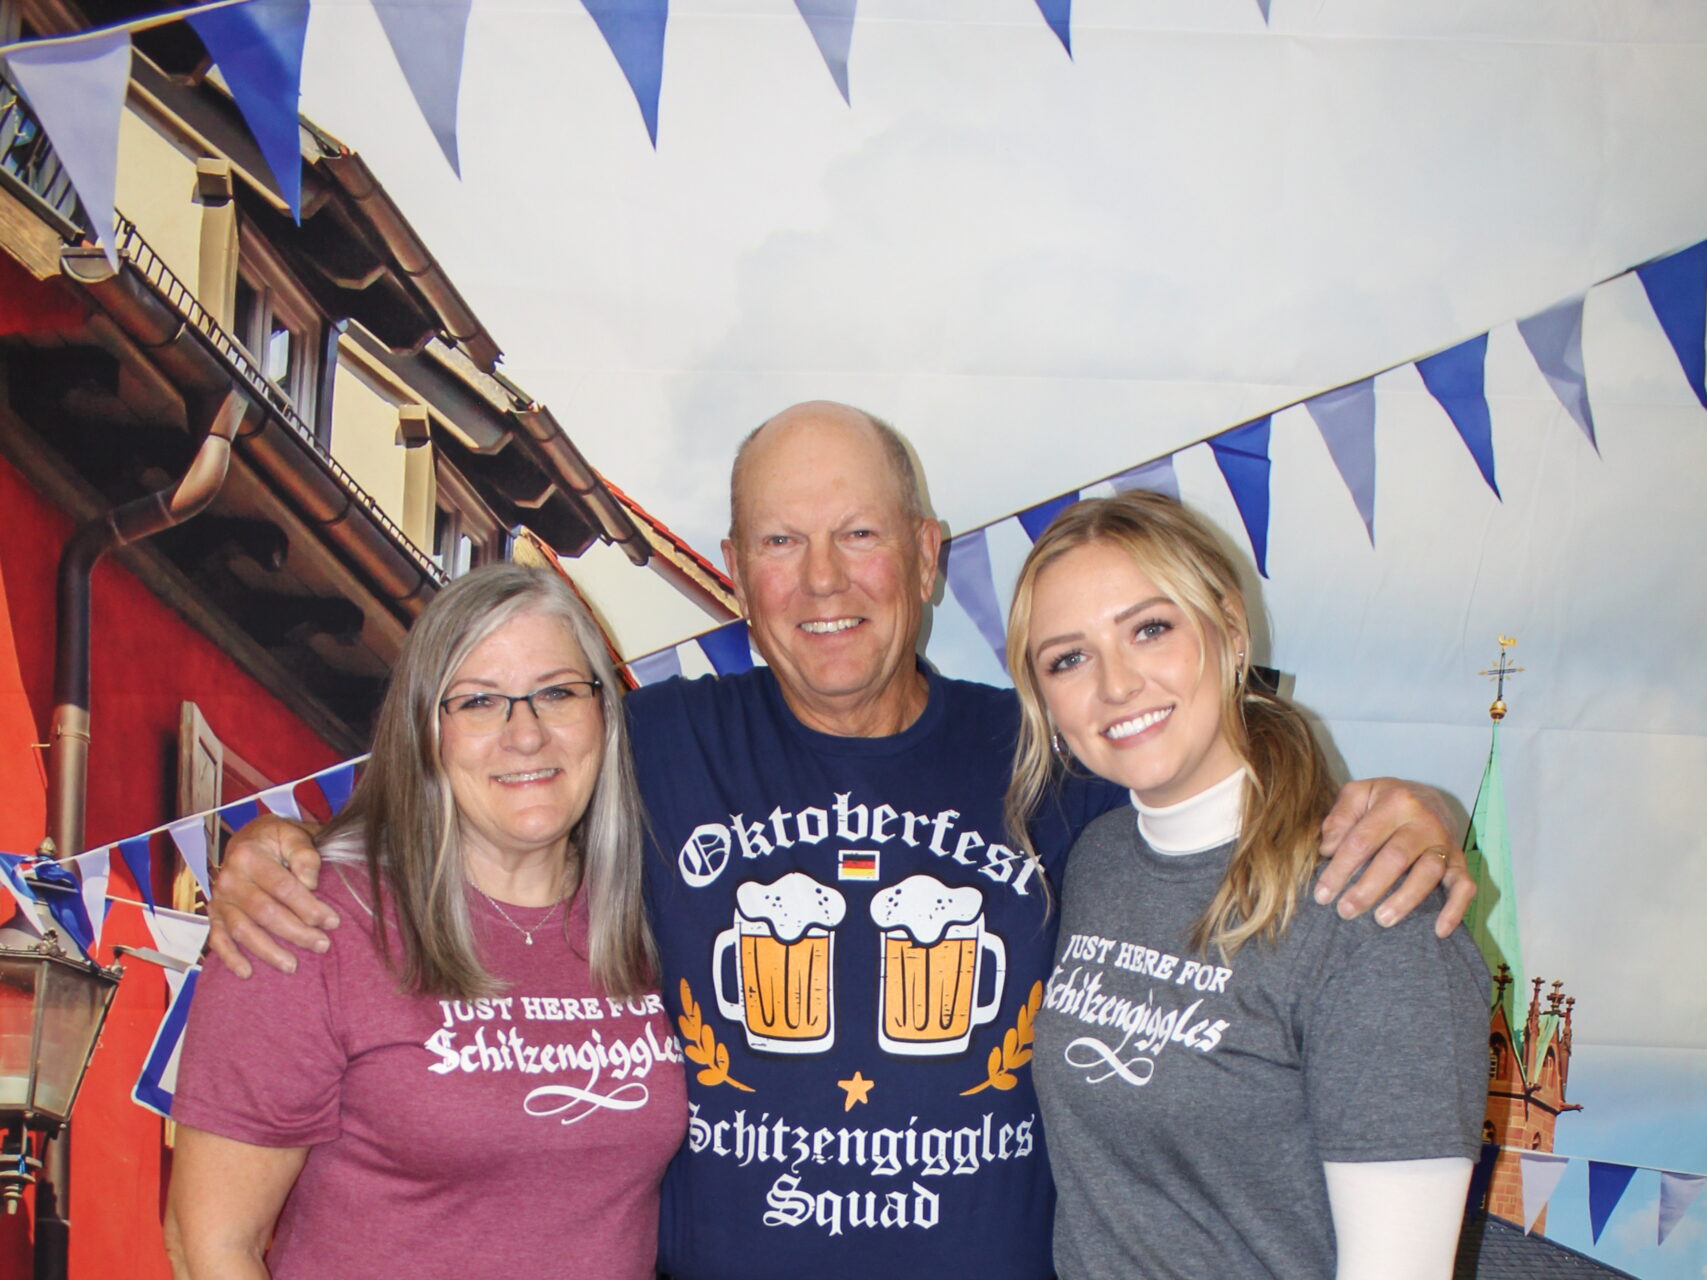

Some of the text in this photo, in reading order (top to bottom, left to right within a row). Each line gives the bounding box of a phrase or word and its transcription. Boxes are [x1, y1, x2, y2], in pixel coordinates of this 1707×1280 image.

[1061, 934, 1233, 993] JUST HERE FOR
[439, 994, 664, 1028] JUST HERE FOR
[762, 1172, 940, 1236] Squad
